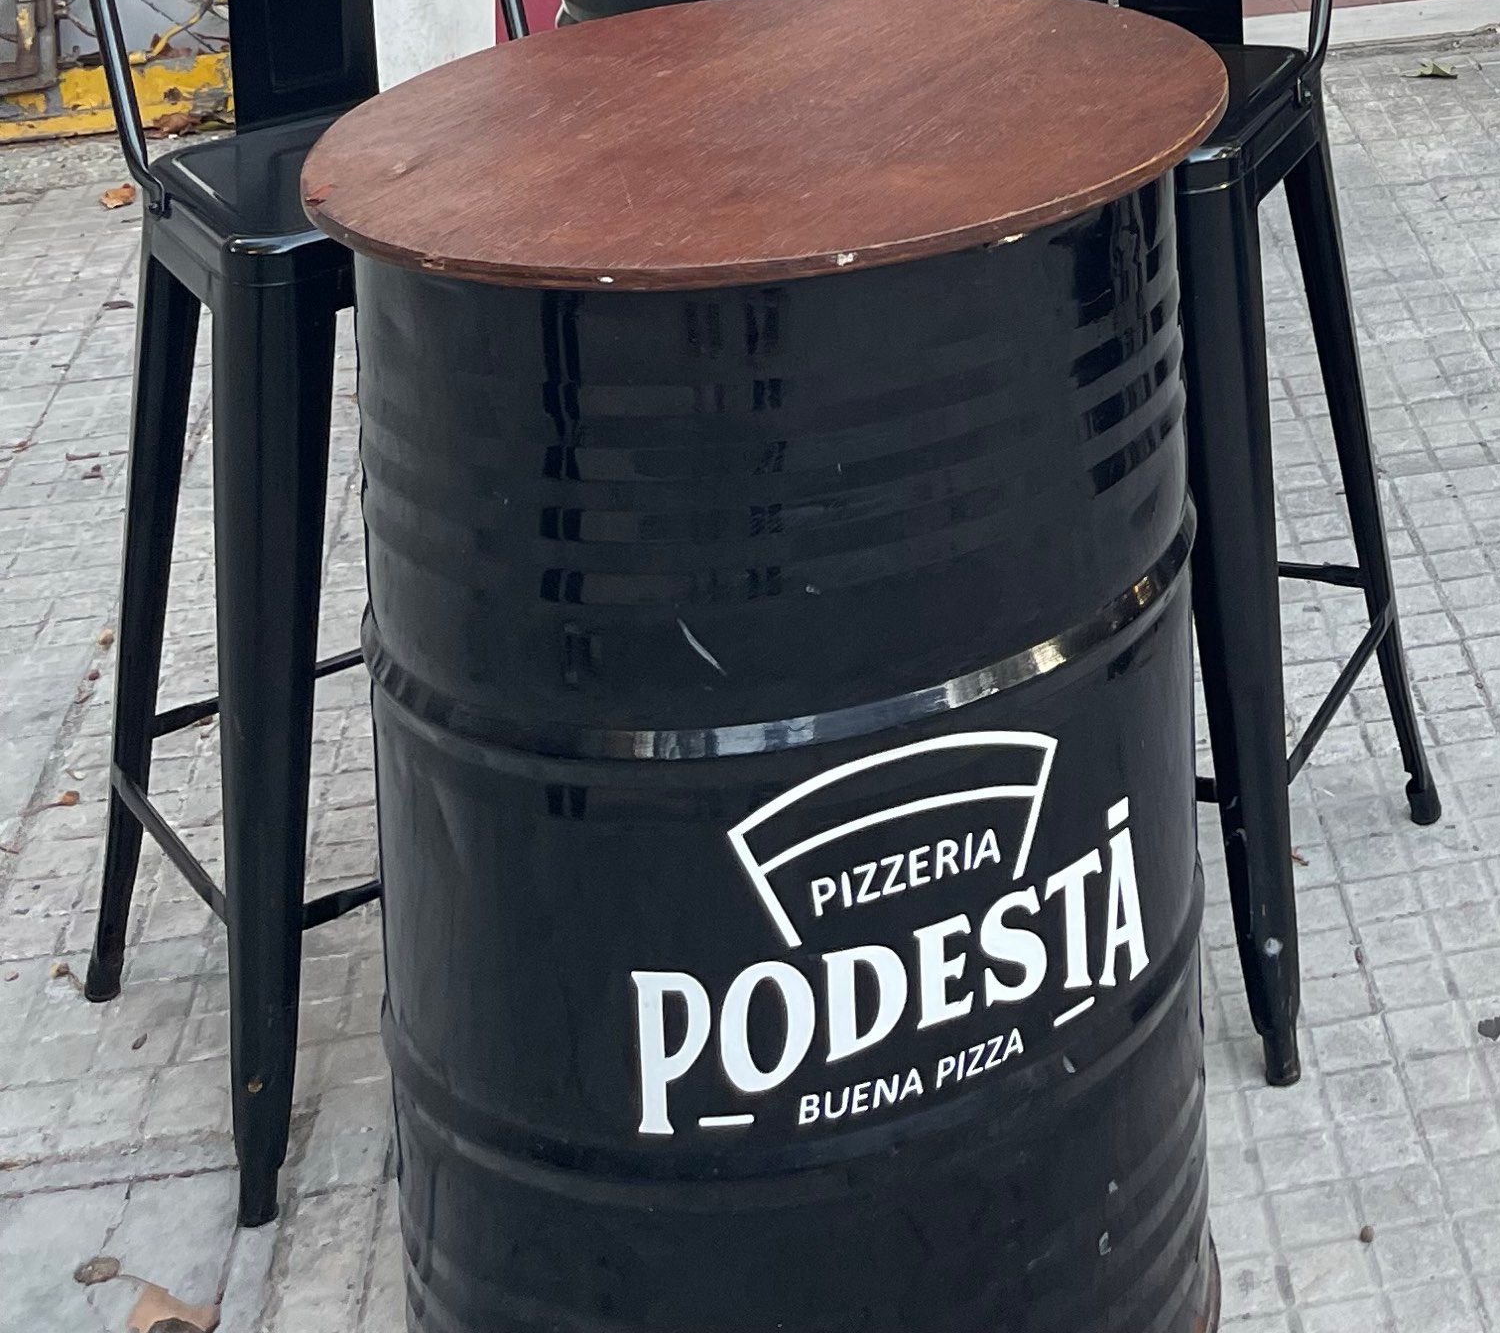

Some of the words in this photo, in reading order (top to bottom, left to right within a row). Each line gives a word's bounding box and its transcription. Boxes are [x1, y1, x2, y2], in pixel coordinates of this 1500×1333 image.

[812, 828, 1001, 917] PIZZERIA
[798, 1068, 924, 1125] BUENA
[935, 1027, 1024, 1089] PIZZA
